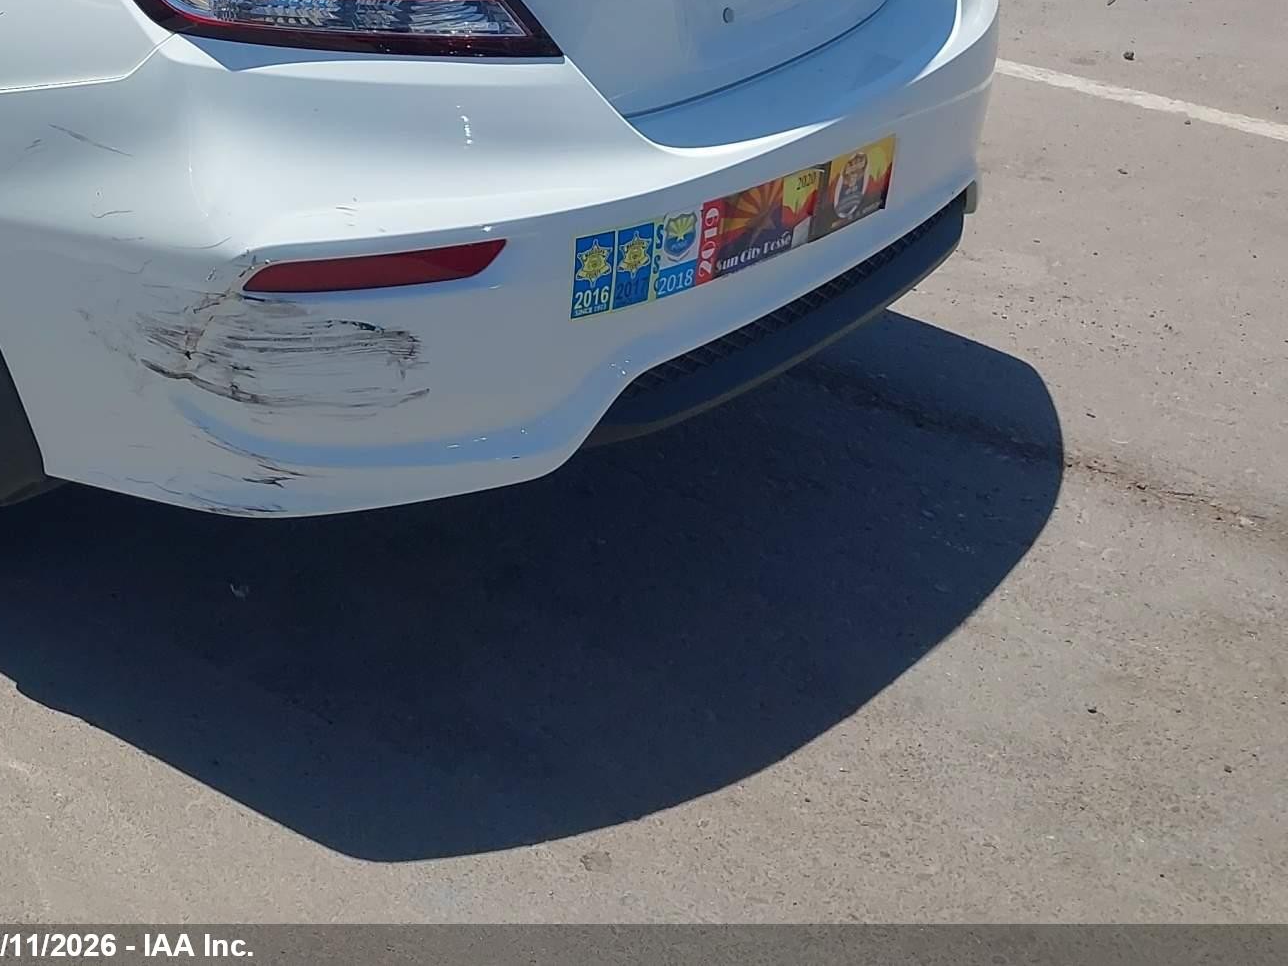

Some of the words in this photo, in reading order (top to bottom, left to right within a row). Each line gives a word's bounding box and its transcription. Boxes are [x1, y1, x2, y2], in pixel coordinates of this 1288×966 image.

[698, 207, 719, 277] 2019
[740, 245, 761, 264] City
[657, 268, 694, 295] 2018
[574, 285, 610, 310] 2016
